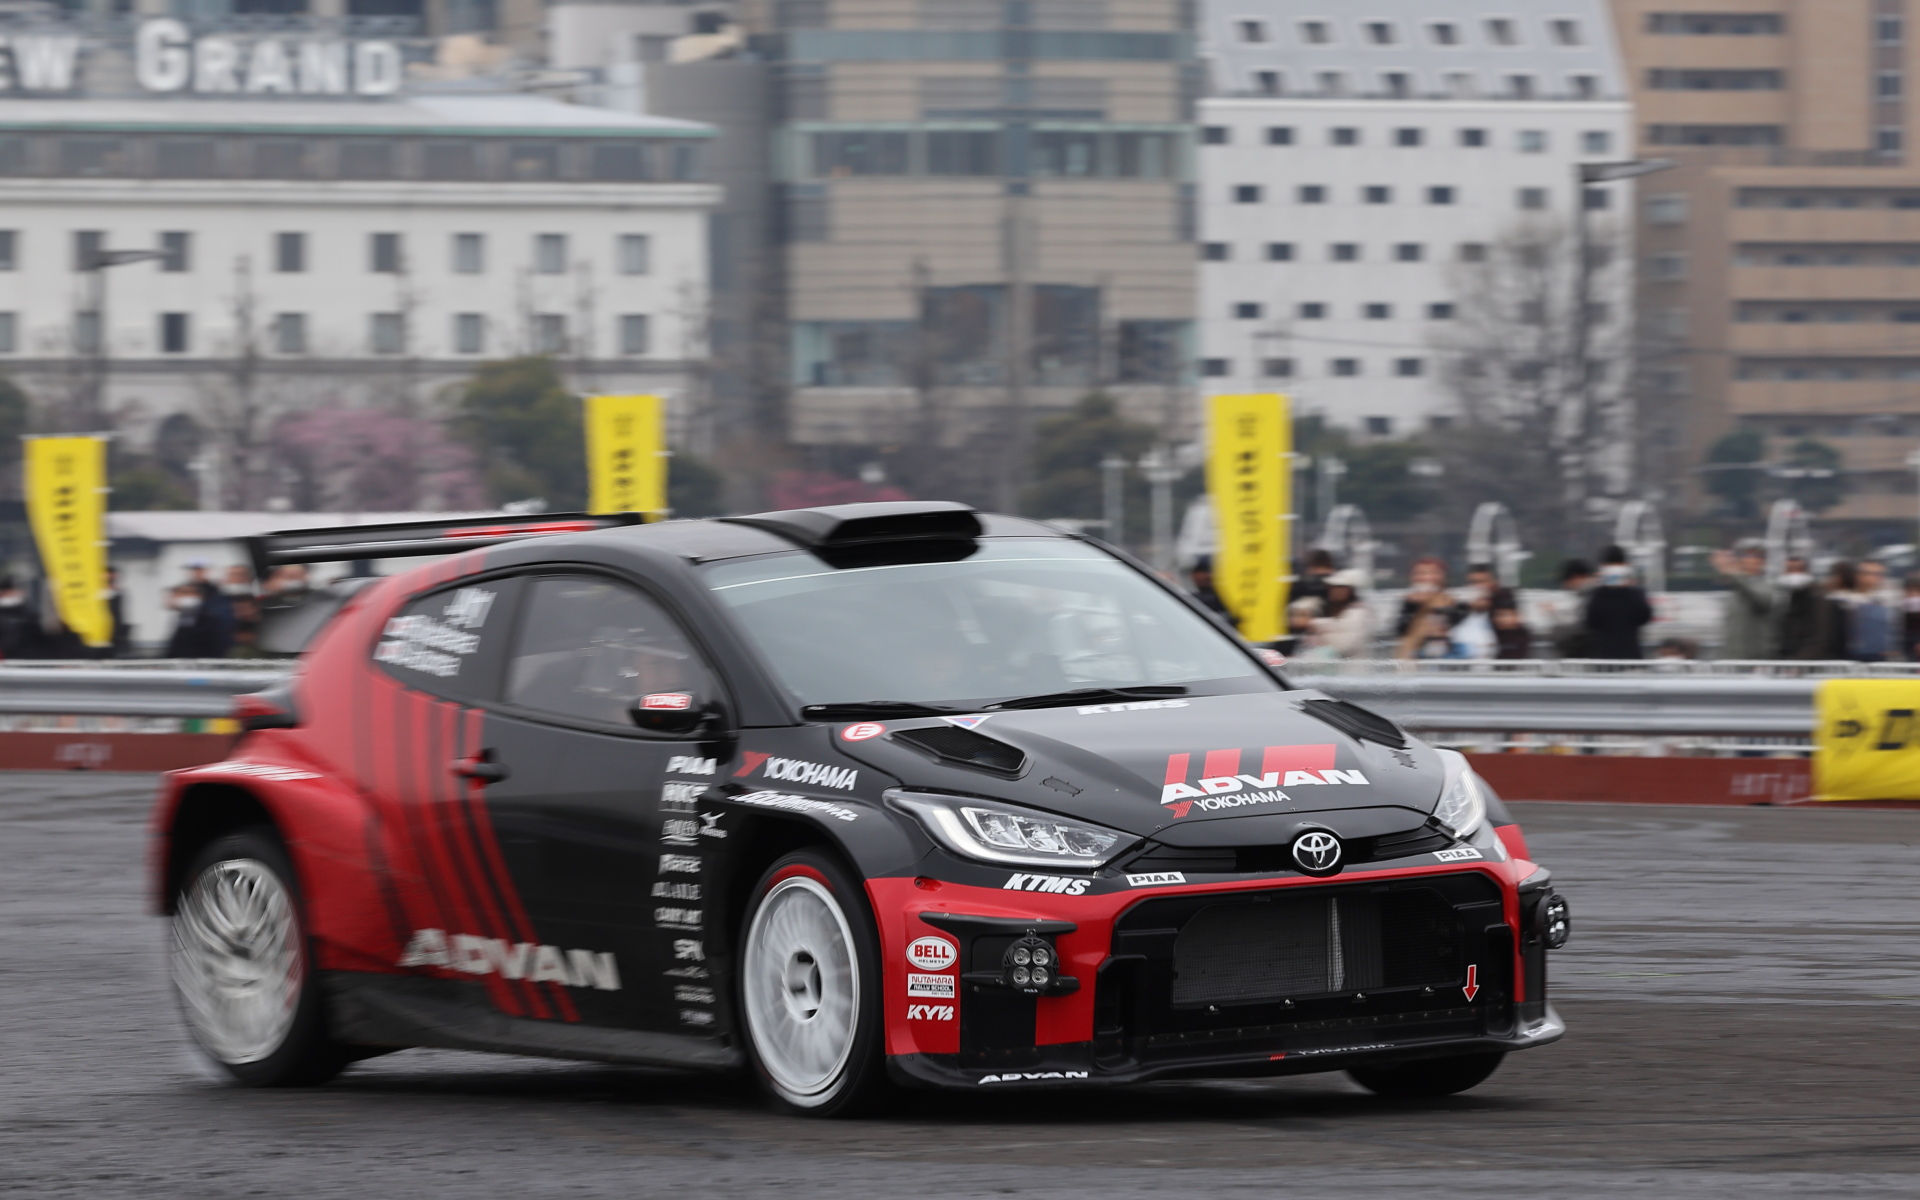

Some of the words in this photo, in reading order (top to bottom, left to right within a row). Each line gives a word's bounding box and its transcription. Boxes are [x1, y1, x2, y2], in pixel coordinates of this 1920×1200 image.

[0, 36, 78, 90] W
[136, 18, 402, 94] GRAND
[1076, 700, 1190, 715] KTMS
[665, 756, 717, 775] PIAA
[763, 756, 858, 791] YOKOHAMA
[1160, 769, 1370, 804] ADVAN
[1194, 790, 1291, 811] YOKOHAMA
[1440, 850, 1476, 859] PIAA
[1003, 873, 1091, 896] KTMS
[1132, 873, 1180, 884] PIAA
[396, 928, 622, 991] ADVAN
[914, 945, 950, 959] BELL
[911, 975, 953, 985] NUTAHARA
[907, 1004, 954, 1021] KYB
[978, 1071, 1089, 1085] ADVAN
